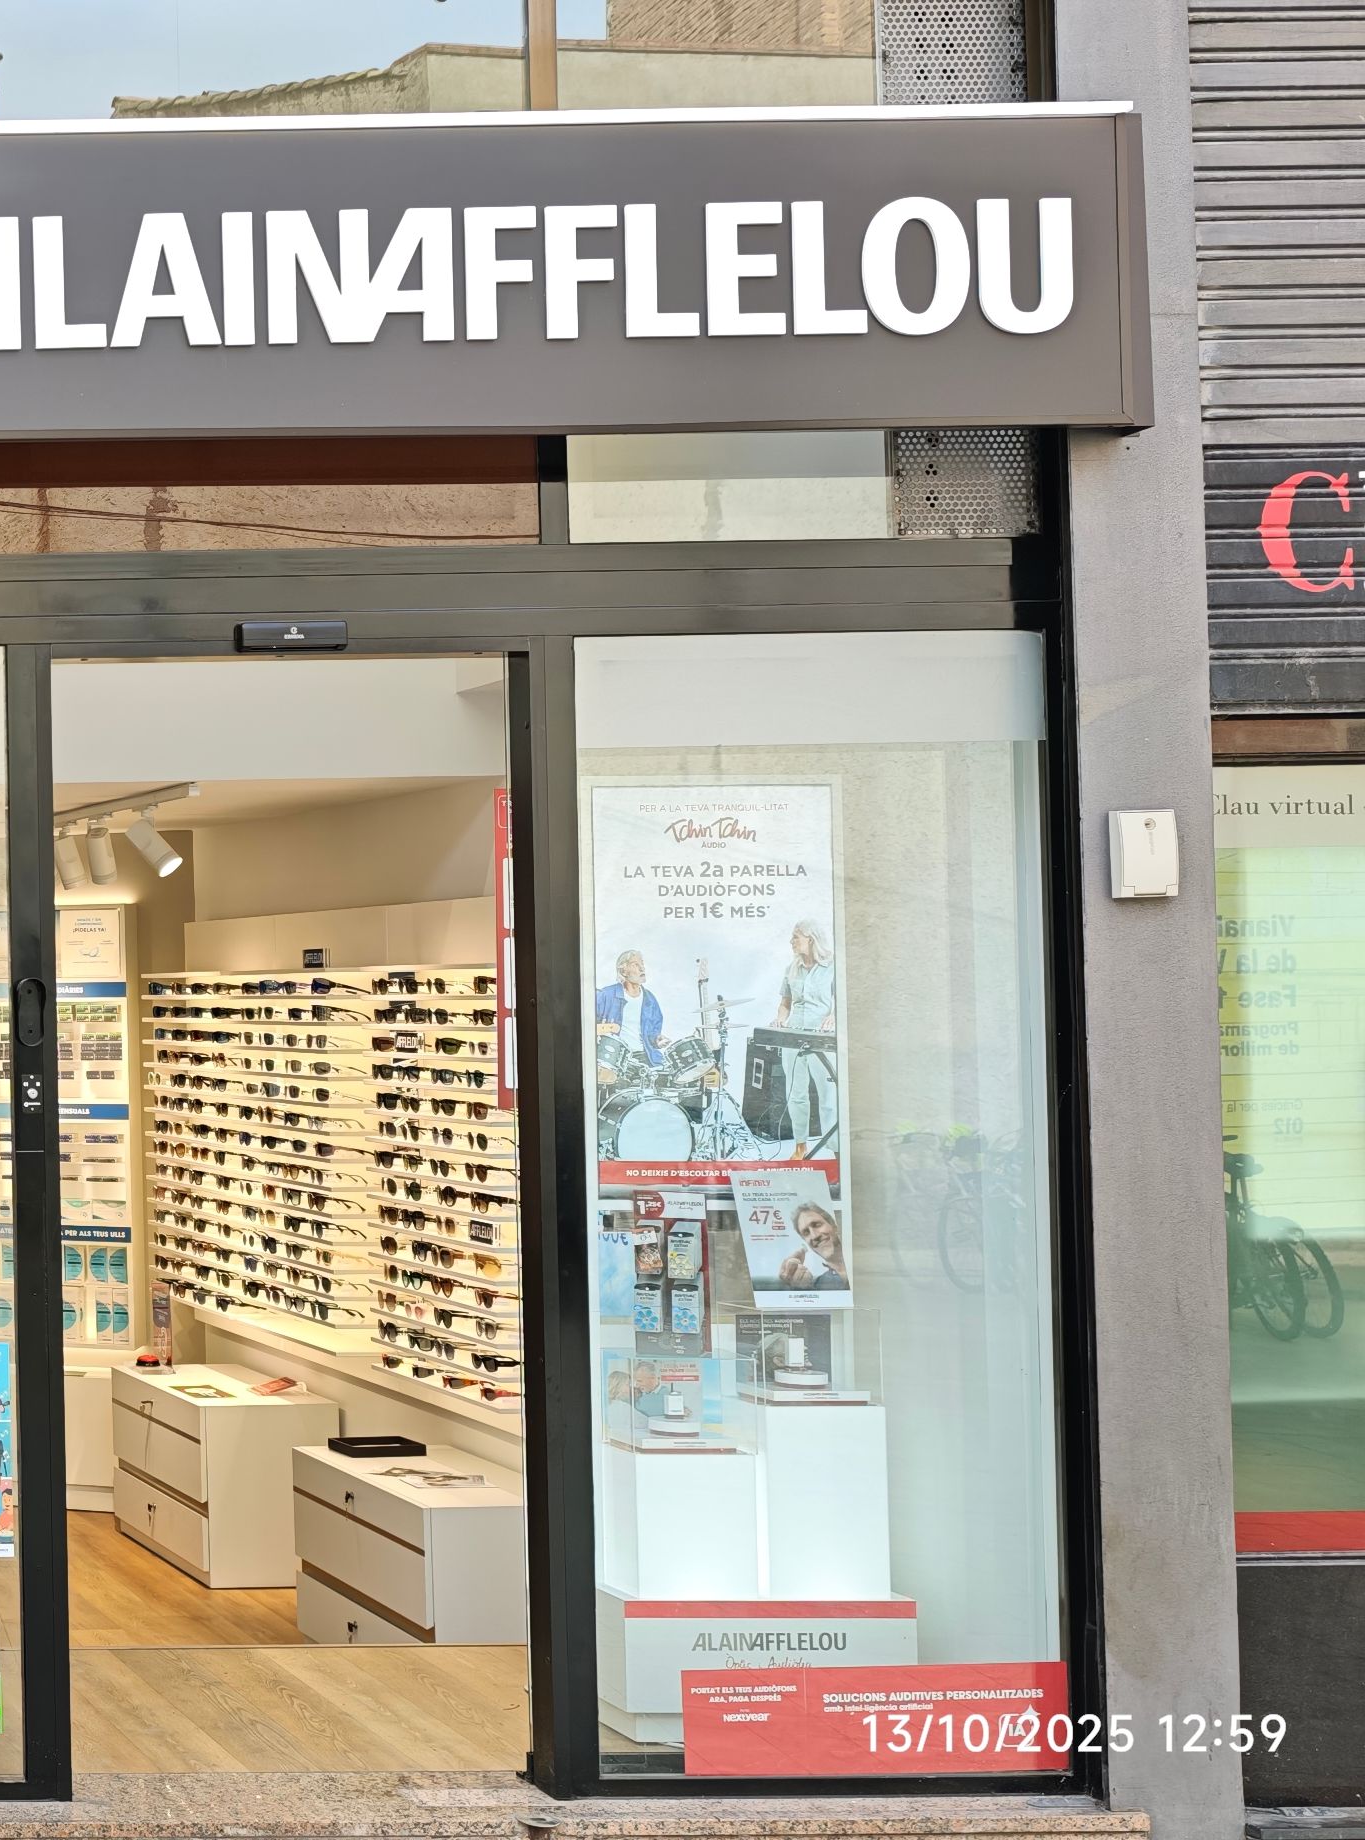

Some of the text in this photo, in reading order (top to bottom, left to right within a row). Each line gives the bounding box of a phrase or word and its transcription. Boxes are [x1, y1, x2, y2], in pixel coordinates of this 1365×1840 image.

[639, 803, 709, 813] PER TEVA
[1268, 794, 1355, 815] virtual
[664, 816, 756, 843] Tchin Tchin
[624, 861, 808, 878] LA TEVA 2a PARELLA
[658, 881, 776, 897] D'AUDIÒFONS
[663, 906, 694, 918] PER
[700, 902, 724, 919] 1€
[626, 1168, 720, 1177] NO DEIXIS D'ESCOLTAR
[749, 1210, 769, 1224] 47
[690, 1686, 720, 1694] PORTA'T
[753, 1683, 797, 1693] AUDIÒFONS
[822, 1688, 1045, 1704] SOLUCIONS AUDITIVES PERSONALITZADES
[709, 1695, 727, 1704] ARA,
[751, 1693, 781, 1702] DESPRÉS
[824, 1702, 934, 1713] amb artificial
